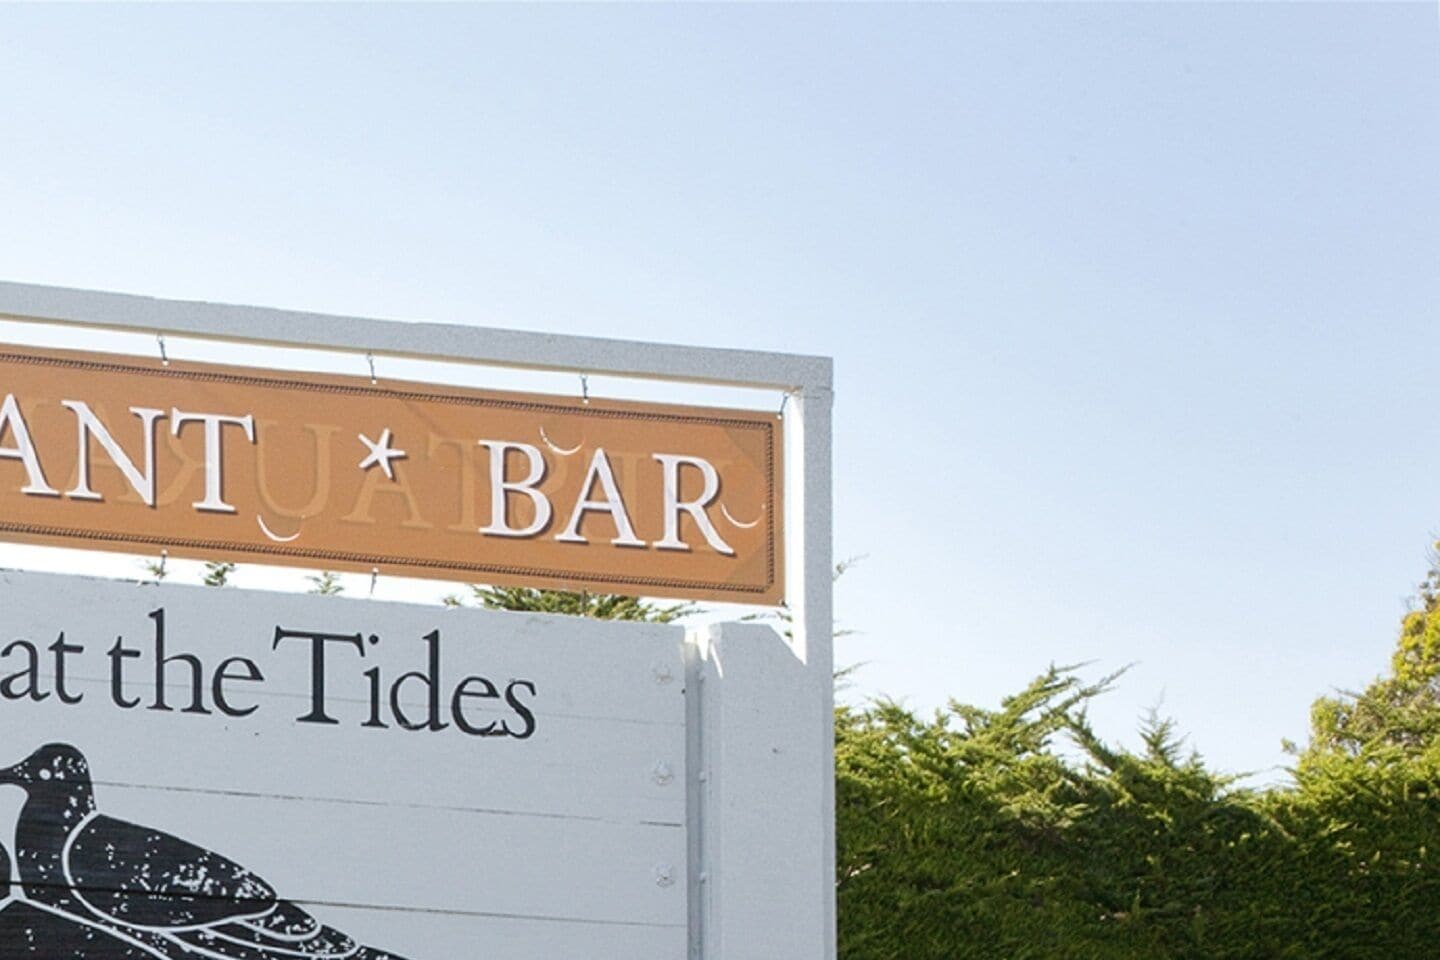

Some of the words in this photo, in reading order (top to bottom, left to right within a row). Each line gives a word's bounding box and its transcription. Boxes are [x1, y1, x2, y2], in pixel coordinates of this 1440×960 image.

[478, 438, 736, 556] BAR
[0, 631, 84, 705] at
[107, 607, 265, 717] the
[272, 625, 537, 740] Tides
